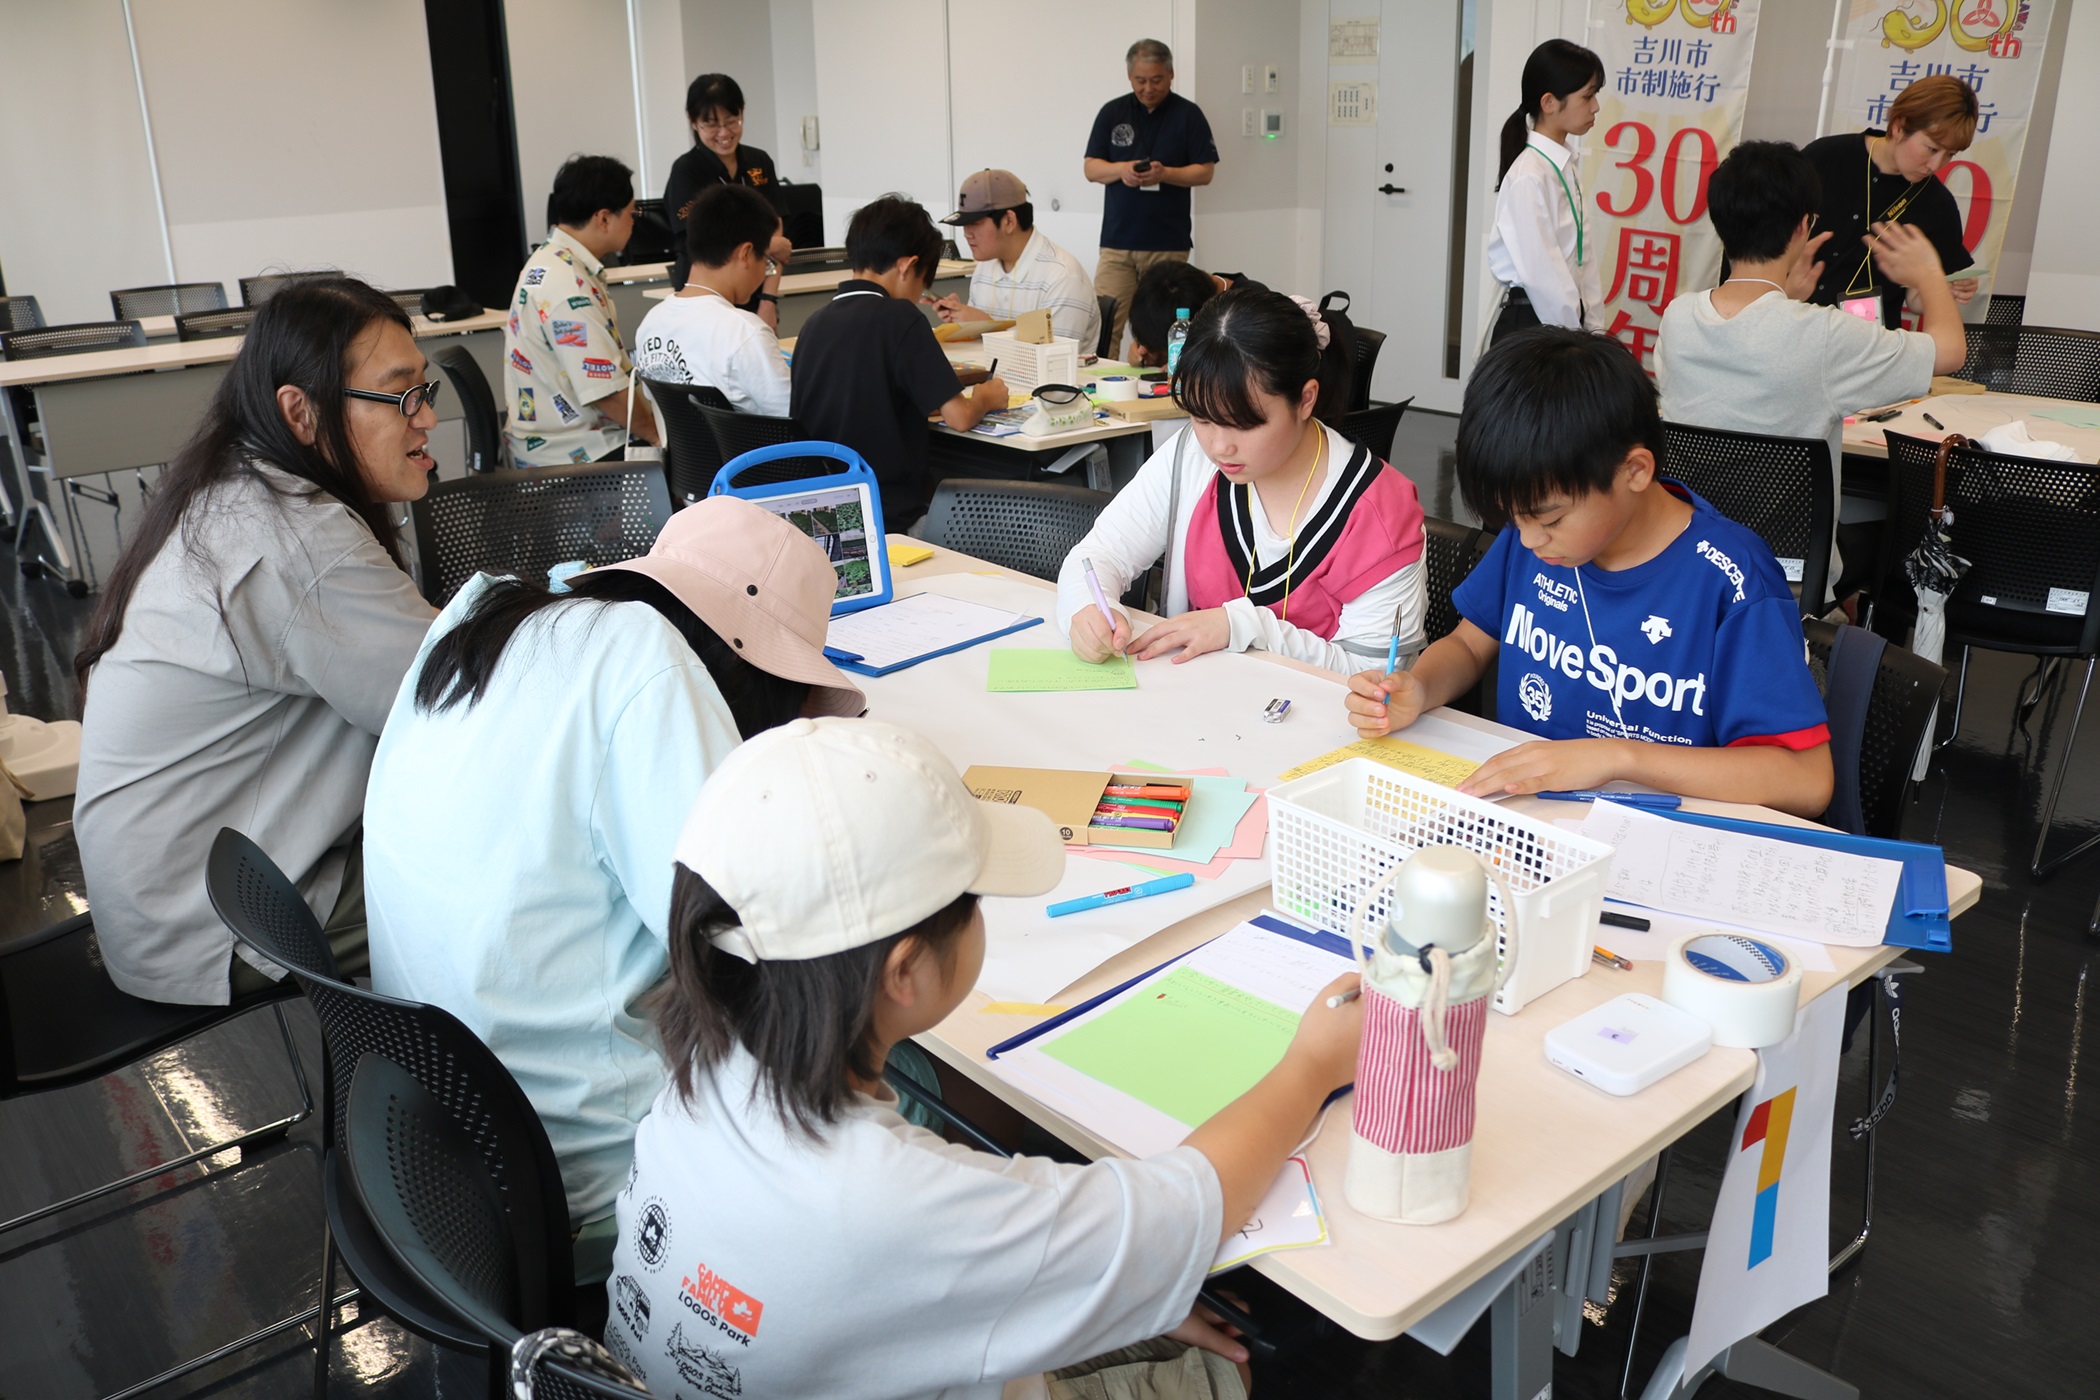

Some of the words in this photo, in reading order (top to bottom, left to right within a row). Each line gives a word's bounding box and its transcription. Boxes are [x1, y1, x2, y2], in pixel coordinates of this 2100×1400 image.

[1633, 36, 1712, 68] 吉川市
[1616, 67, 1721, 103] 市制施行
[1596, 121, 1718, 224] 30
[1887, 198, 1907, 218] Nikon
[1533, 572, 1578, 604] ATHLETIC
[1537, 589, 1568, 612] Originals
[1526, 685, 1545, 709] 35
[1586, 710, 1639, 732] Universal
[1643, 726, 1693, 745] Function
[1741, 1085, 1797, 1271] 1
[678, 1290, 718, 1327] LOGOS
[719, 1321, 751, 1347] Park
[676, 1358, 704, 1380] LOGOS
